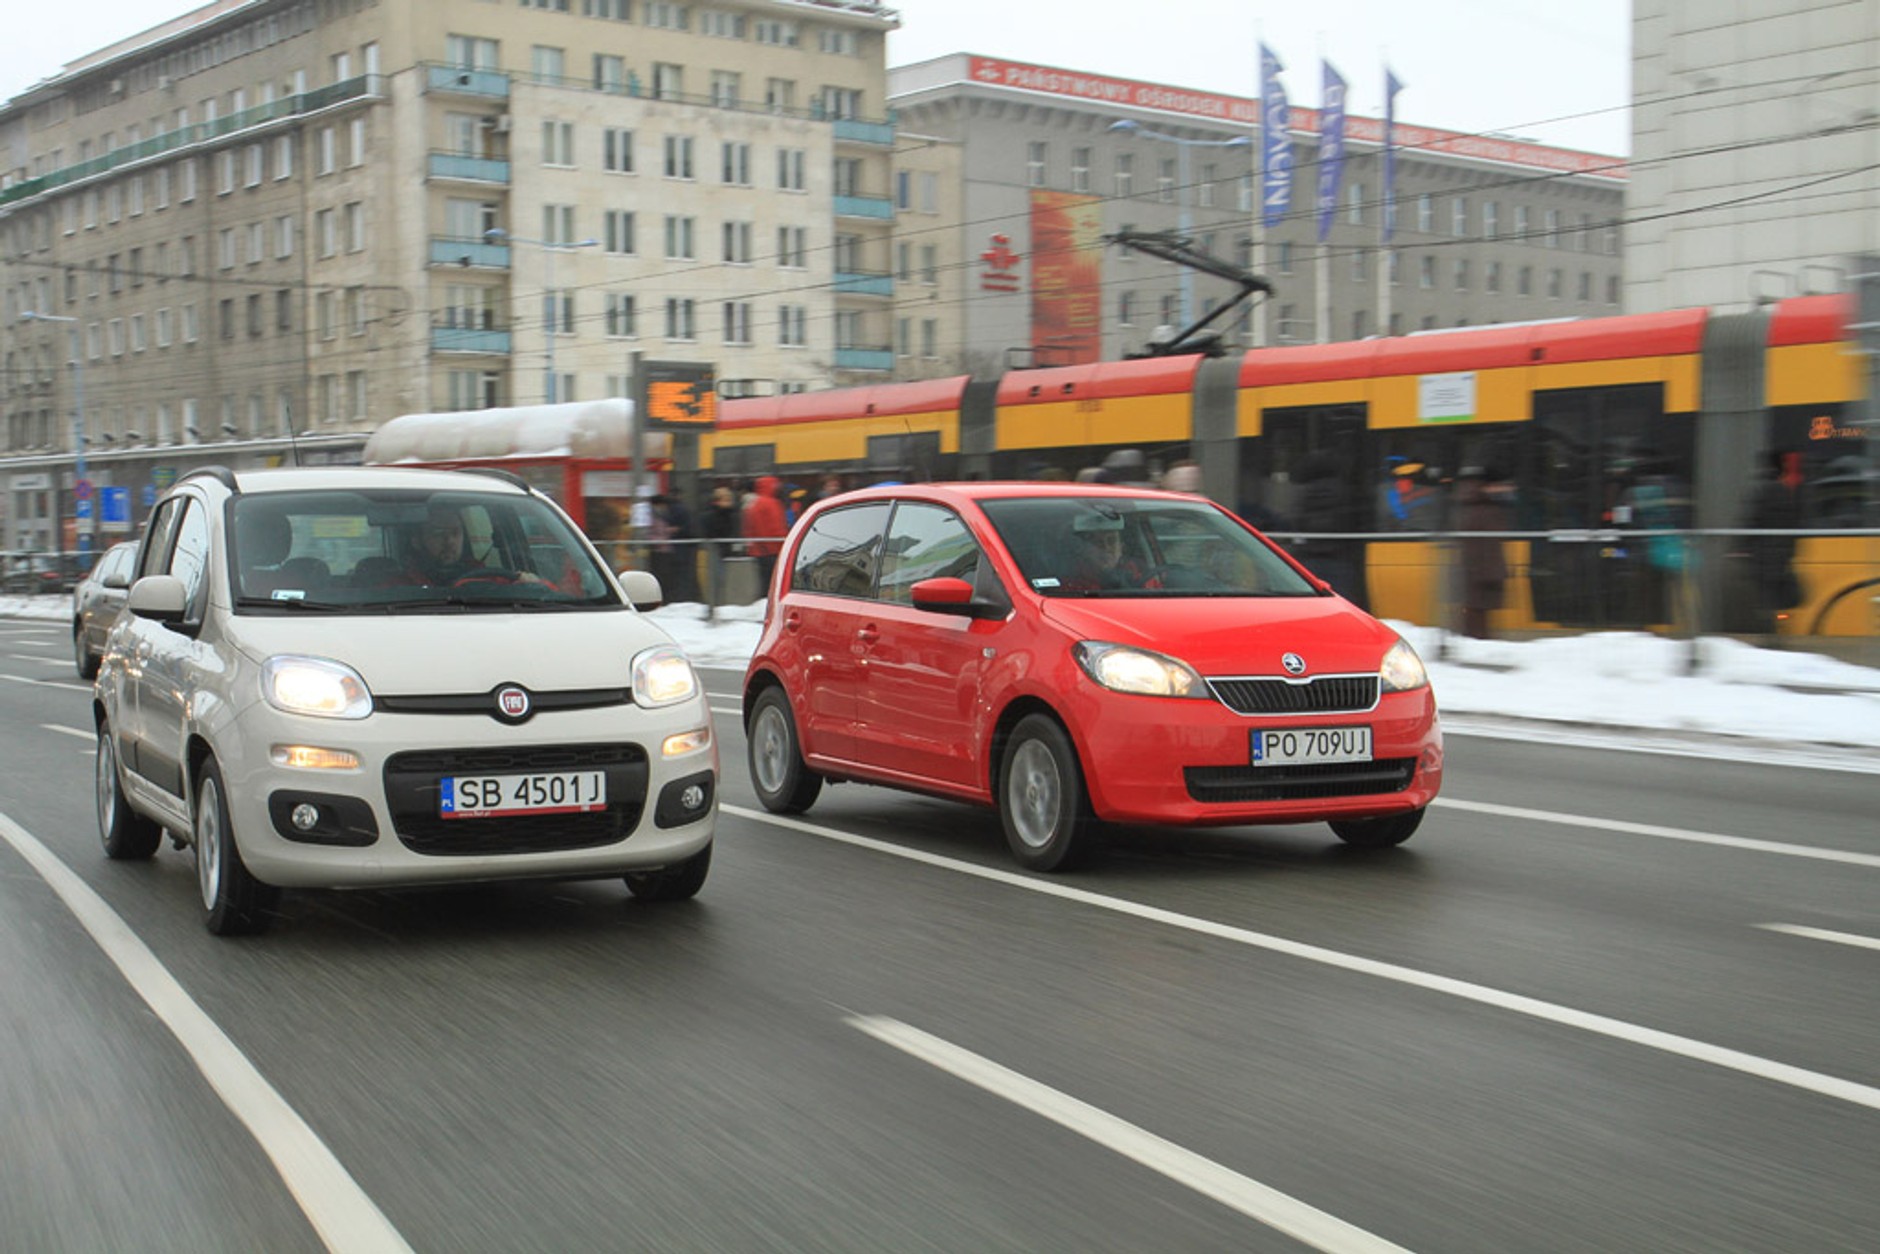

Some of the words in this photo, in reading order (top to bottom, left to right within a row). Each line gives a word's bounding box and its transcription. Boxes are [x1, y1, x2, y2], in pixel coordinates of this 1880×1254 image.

[1265, 732, 1297, 758] PO
[1305, 730, 1366, 756] 709UJ
[459, 779, 502, 809] SB
[513, 773, 599, 806] 4501J
